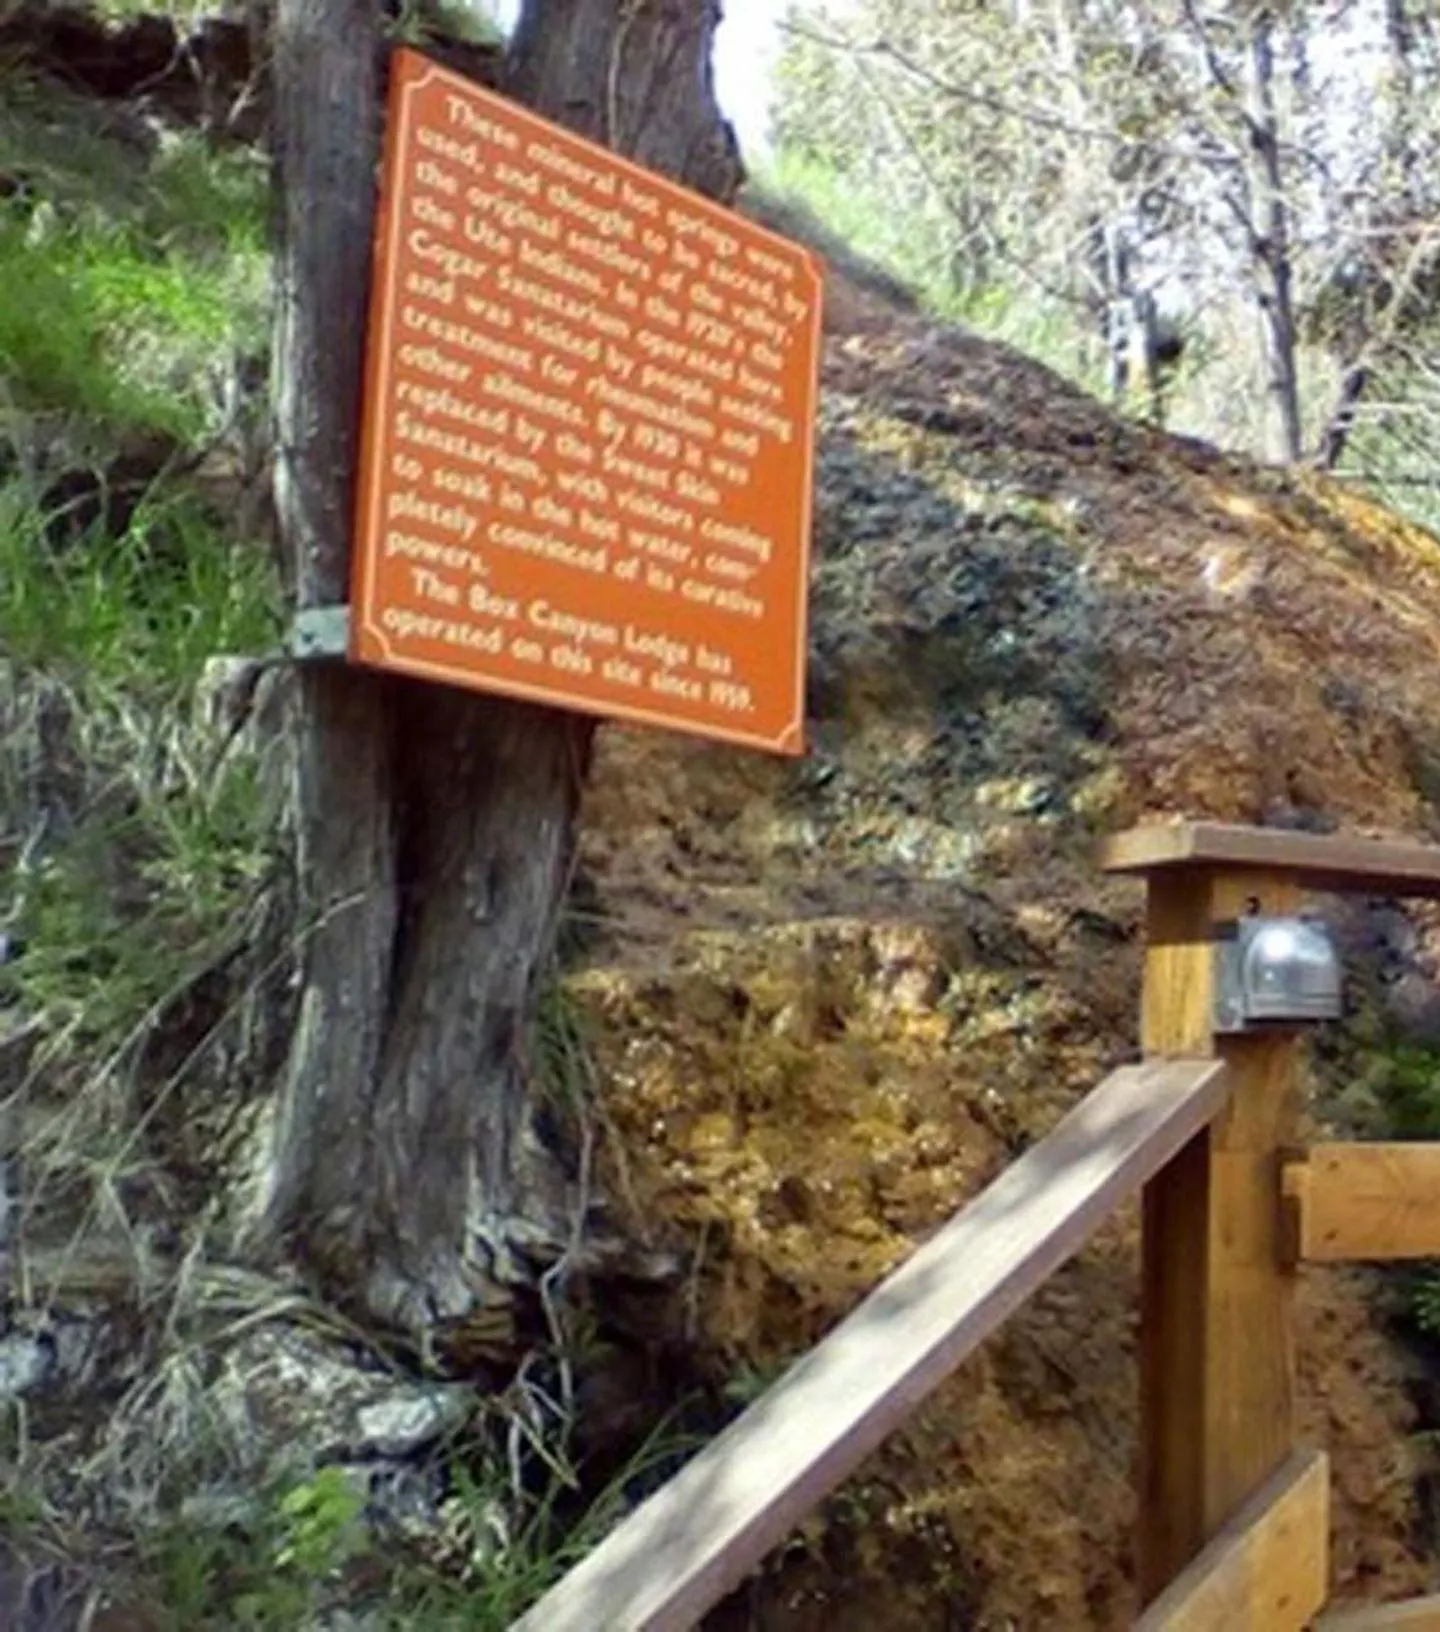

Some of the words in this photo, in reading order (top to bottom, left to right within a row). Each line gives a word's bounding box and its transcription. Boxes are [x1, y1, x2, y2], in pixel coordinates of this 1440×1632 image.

[415, 127, 485, 173] used,
[494, 162, 539, 194] and
[547, 185, 633, 238] thought
[642, 228, 667, 253] to
[672, 239, 699, 268] be
[707, 260, 777, 307] sacred,
[783, 291, 807, 322] by
[445, 94, 518, 149] These
[526, 143, 615, 194] mineral
[621, 180, 658, 216] hot
[666, 209, 739, 256] springs
[746, 247, 794, 280] were
[411, 196, 455, 230] the
[464, 215, 511, 254] Ute
[519, 238, 608, 295] Indians.
[616, 280, 637, 307] In
[645, 296, 680, 326] the
[751, 342, 782, 369] the
[415, 160, 457, 194] the
[466, 186, 559, 238] original
[658, 271, 683, 293] of
[689, 283, 723, 311] the
[732, 305, 793, 344] valley,
[402, 305, 532, 370] treatment
[541, 354, 577, 385] for
[721, 430, 758, 456] and
[406, 272, 454, 304] and
[464, 295, 511, 327] was
[522, 315, 600, 361] visited
[606, 344, 634, 378] by
[641, 364, 712, 404] people
[636, 329, 733, 380] operated
[738, 364, 782, 399] here
[395, 381, 508, 433] replaced
[515, 415, 545, 453] by
[555, 433, 593, 463] the
[398, 344, 471, 381] other
[482, 374, 587, 425] ailments.
[597, 409, 626, 449] By
[685, 441, 701, 467] it
[710, 458, 748, 483] was
[385, 531, 486, 575] powers.
[388, 491, 477, 540] pletely
[487, 522, 606, 572] convinced
[613, 556, 639, 580] of
[647, 562, 673, 590] its
[392, 453, 422, 480] to
[433, 469, 490, 501] soak
[499, 483, 524, 510] in
[532, 496, 571, 526] the
[579, 509, 619, 541] hot
[628, 530, 697, 568] water,
[557, 473, 607, 501] with
[616, 490, 693, 529] visitors
[699, 518, 770, 561] coming
[382, 607, 501, 652] operated
[511, 637, 543, 662] on
[550, 645, 592, 673] this
[602, 659, 641, 685] site
[650, 672, 701, 698] since
[411, 567, 458, 604] The
[469, 583, 517, 618] Box
[528, 599, 617, 644] Canyon
[624, 625, 688, 667] Lodge
[696, 645, 731, 673] has
